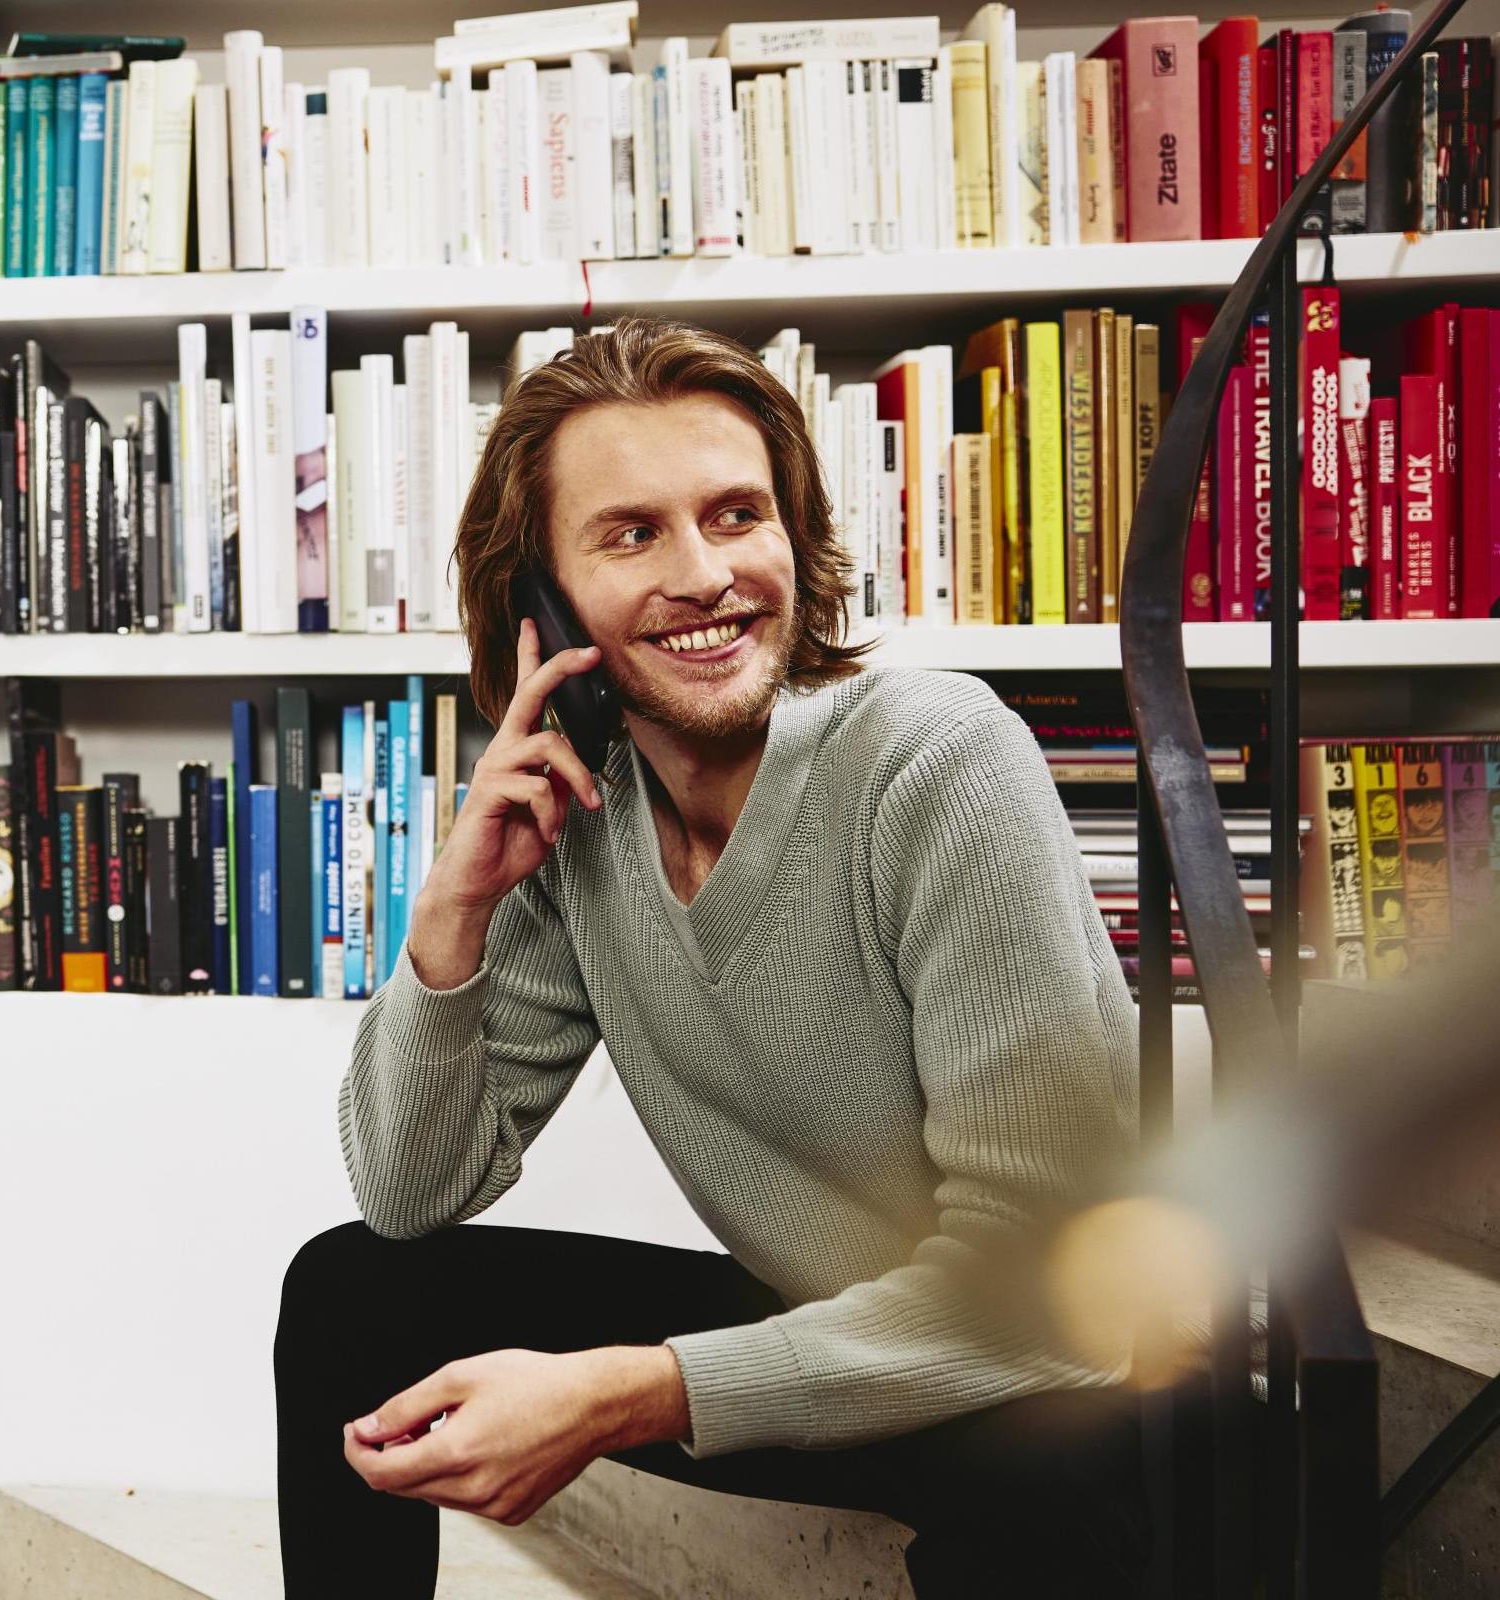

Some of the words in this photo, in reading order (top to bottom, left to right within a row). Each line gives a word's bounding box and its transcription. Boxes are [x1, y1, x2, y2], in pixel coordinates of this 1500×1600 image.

[1238, 54, 1252, 164] ENCYCLOPAEDIA
[543, 113, 569, 199] Sapiens
[1157, 133, 1178, 205] Zitate
[1254, 336, 1270, 389] THE
[1071, 370, 1091, 419] WES
[1139, 403, 1154, 450] KOPF
[1254, 396, 1270, 499] TRAVEL
[1379, 419, 1395, 484] PROTEST!
[1070, 423, 1093, 533] ANDERSON
[1407, 452, 1433, 522] BLACK
[1407, 531, 1420, 596] CHARLES
[1421, 540, 1433, 586] BURNS
[377, 733, 386, 789] PICASSO
[1334, 766, 1346, 786] 3
[1374, 766, 1384, 786] 1
[1416, 765, 1428, 785] 6
[1462, 766, 1475, 785] 4
[60, 812, 71, 863] RUSSO
[347, 789, 362, 840] COME
[347, 849, 362, 870] TO
[62, 867, 74, 934] RICHARD
[347, 880, 363, 952] THINGS
